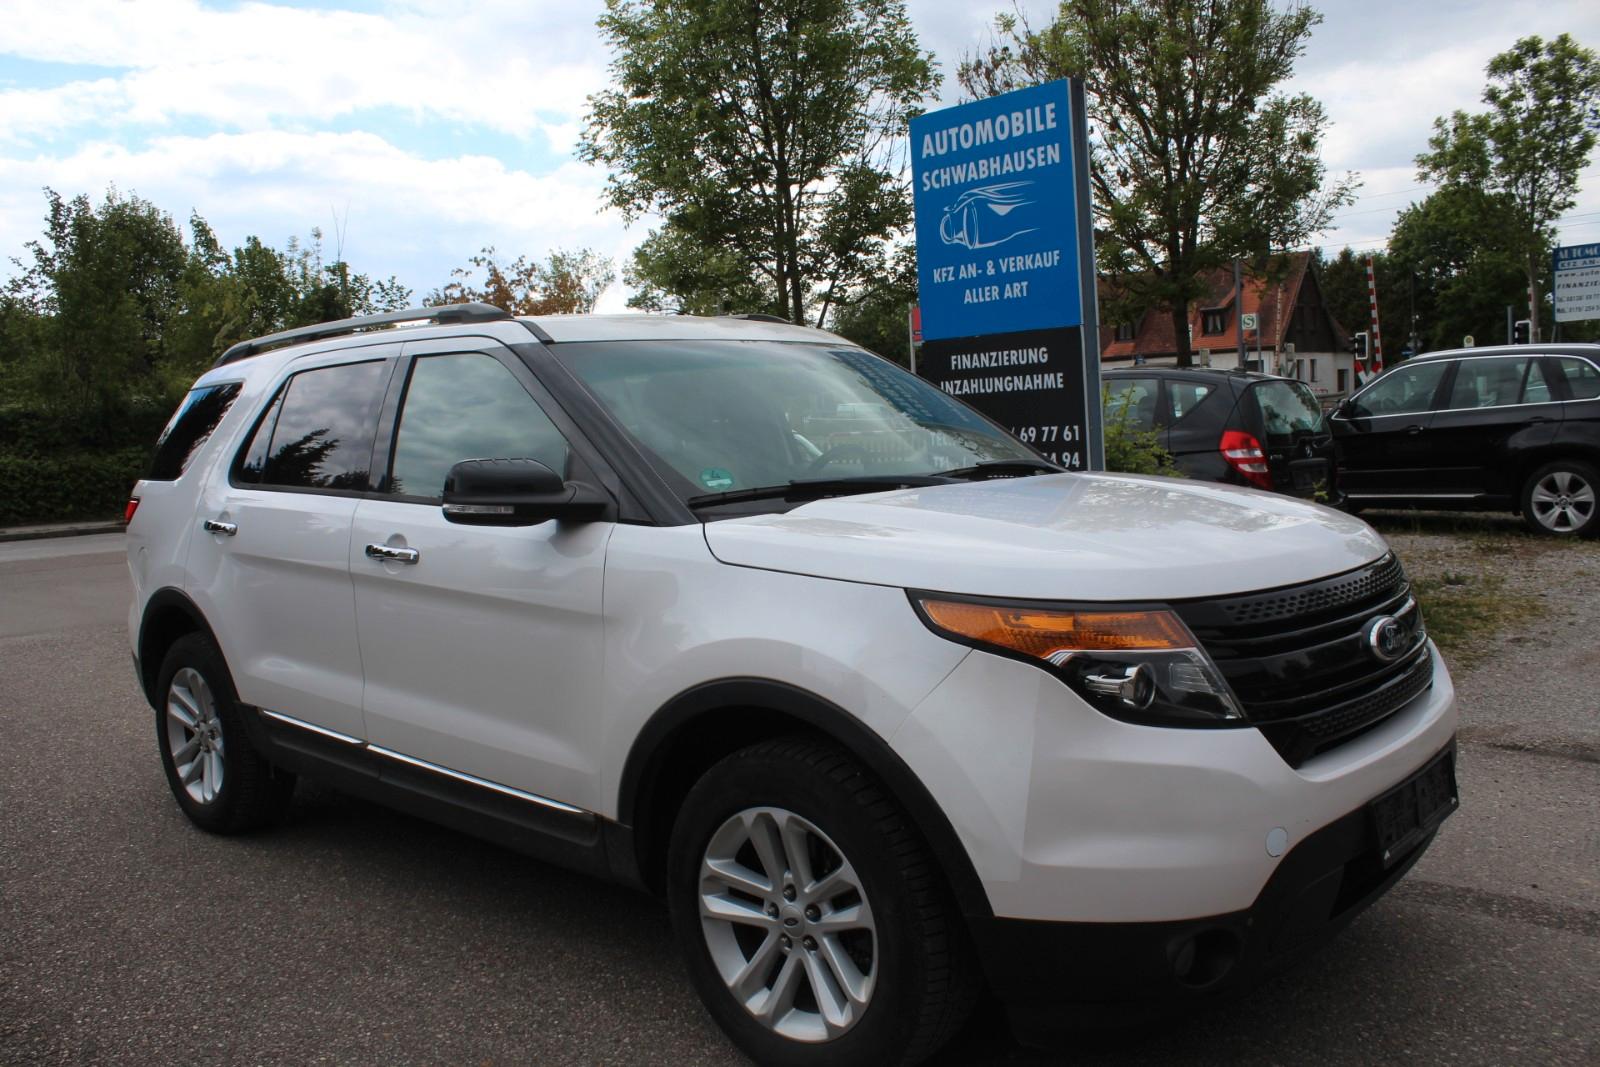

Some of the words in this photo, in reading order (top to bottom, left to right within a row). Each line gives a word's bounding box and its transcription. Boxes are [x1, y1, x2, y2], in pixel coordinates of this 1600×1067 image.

[921, 102, 1057, 159] AUTOMOBILE
[922, 143, 1061, 192] SCHWABHAUSEN
[933, 266, 955, 283] KFZ
[959, 263, 982, 280] AN-
[986, 260, 996, 276] &
[999, 250, 1060, 273] VERKAUF
[964, 285, 999, 304] ALLER
[1004, 281, 1029, 299] ART
[951, 347, 1048, 370] FINANZIERUNG
[941, 372, 1064, 395] INZAHLUNGNAHME
[1020, 427, 1037, 442] 69
[1041, 426, 1058, 441] 77
[1063, 425, 1079, 441] 61
[1062, 451, 1080, 468] 94
